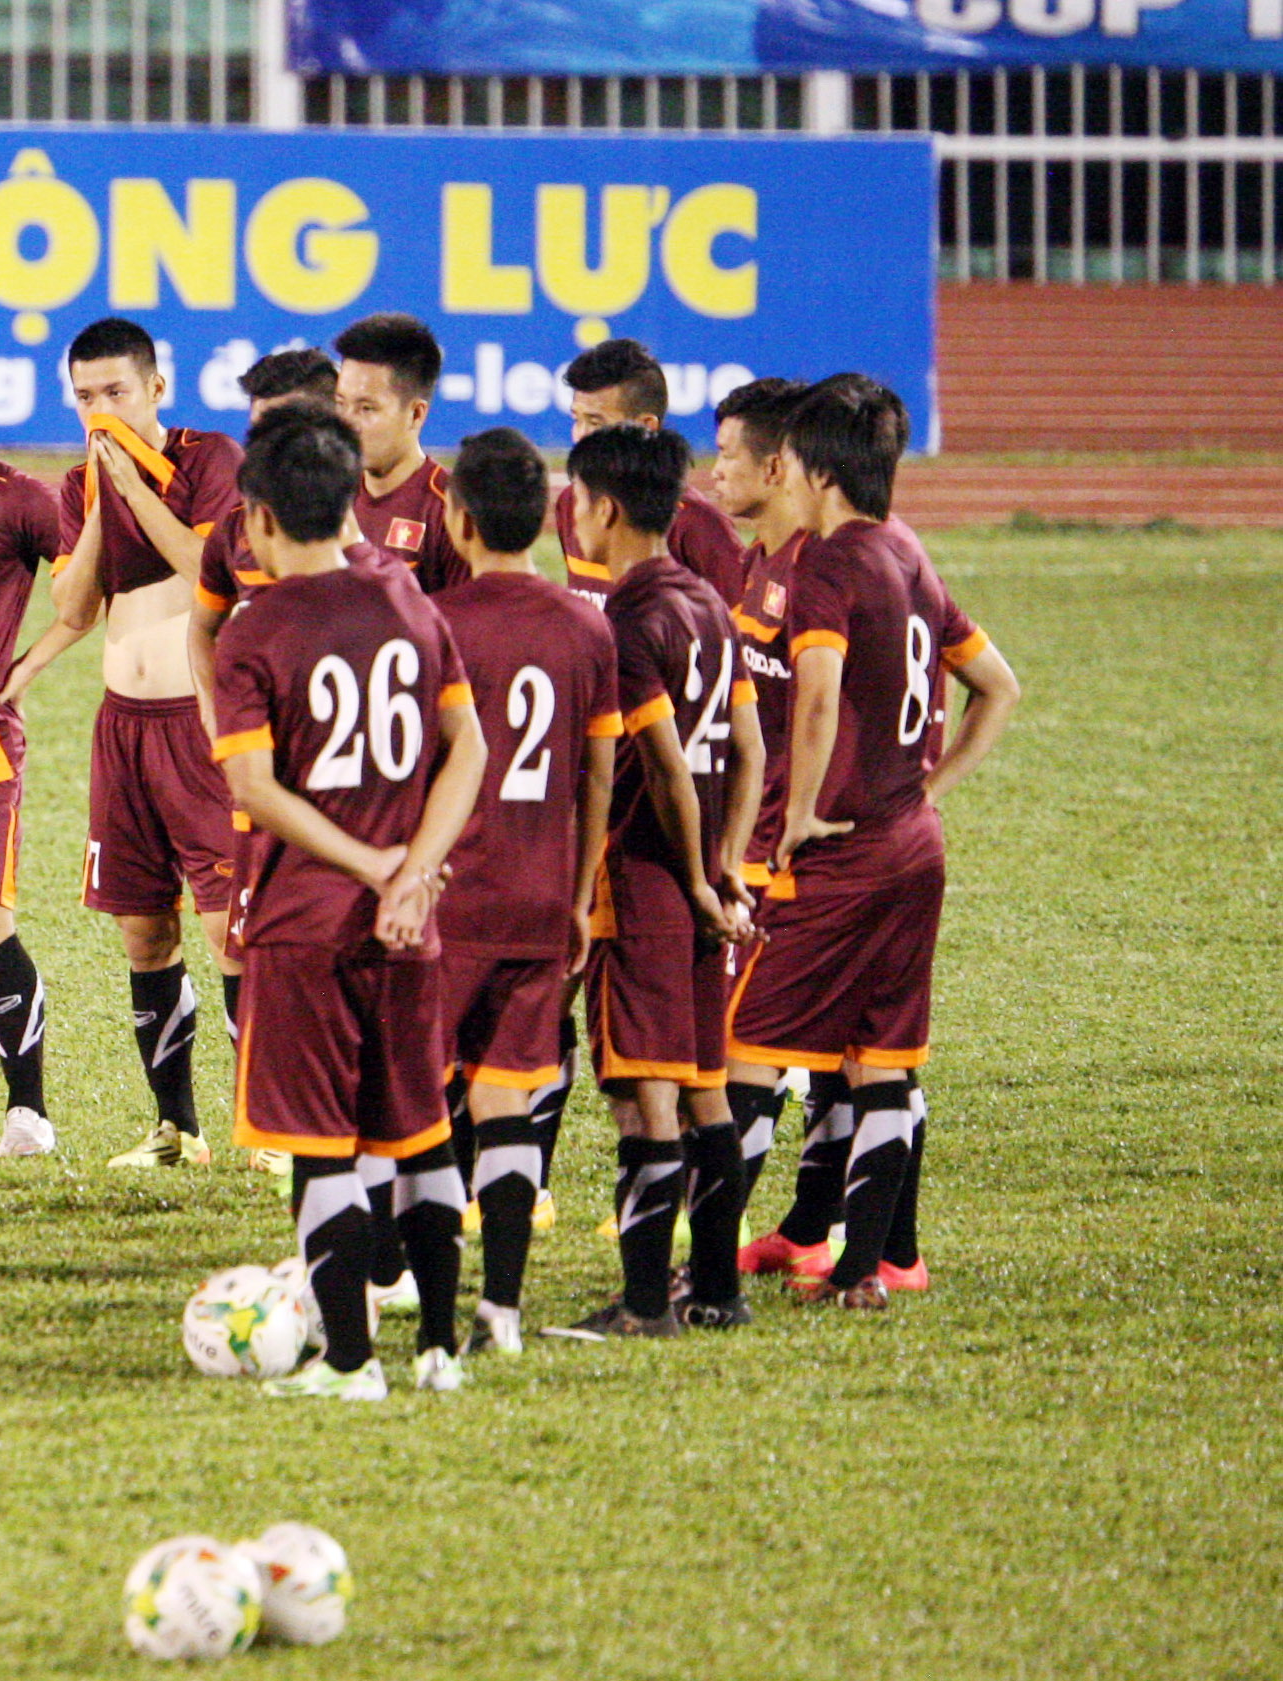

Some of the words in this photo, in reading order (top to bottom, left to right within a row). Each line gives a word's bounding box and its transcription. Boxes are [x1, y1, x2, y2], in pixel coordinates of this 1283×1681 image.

[441, 182, 758, 348] LỰC
[306, 638, 424, 790] 26
[499, 665, 555, 801] 2
[899, 615, 931, 745] 8
